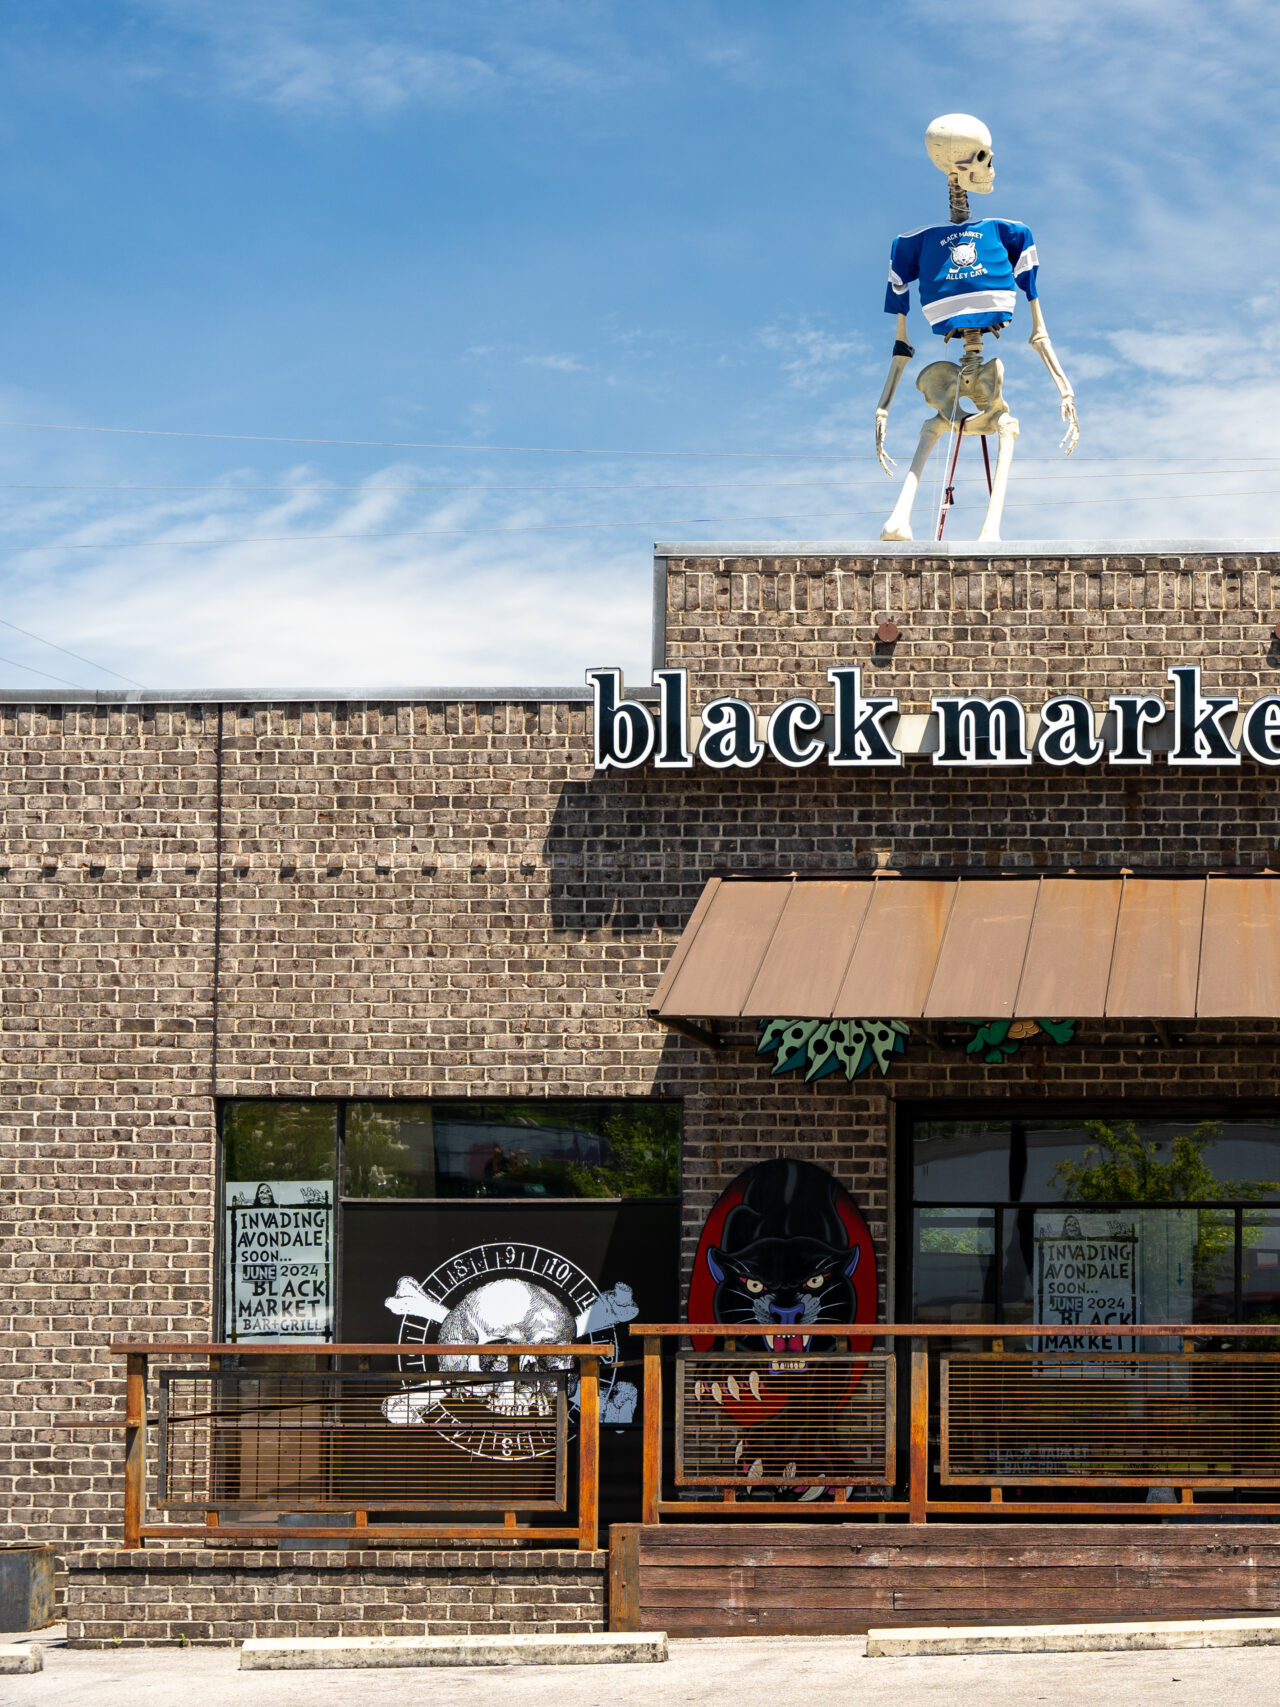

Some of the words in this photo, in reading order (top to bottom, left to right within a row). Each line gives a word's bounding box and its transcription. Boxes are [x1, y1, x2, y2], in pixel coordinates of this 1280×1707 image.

[940, 233, 958, 246] BLACK
[959, 231, 983, 239] MARKET
[946, 272, 968, 280] ALLEY
[970, 268, 988, 277] CATS
[585, 666, 902, 771] black
[241, 1211, 325, 1229] INVADING
[237, 1231, 322, 1248] AVONDALE
[241, 1250, 292, 1262] SOON...
[1048, 1245, 1131, 1260] INVADING
[506, 1246, 515, 1264] 9
[547, 1258, 569, 1280] 10
[243, 1265, 276, 1280] JUNE
[280, 1265, 318, 1277] 2024
[1045, 1263, 1129, 1279] AVONDALE
[252, 1280, 325, 1298] BLACK
[1048, 1282, 1098, 1294] SOON...
[238, 1299, 320, 1318] MARKET
[1050, 1296, 1083, 1312] JUNE
[1087, 1298, 1125, 1309] 2024
[243, 1319, 322, 1331] BAR+GRILL
[1060, 1311, 1131, 1325] BLACK
